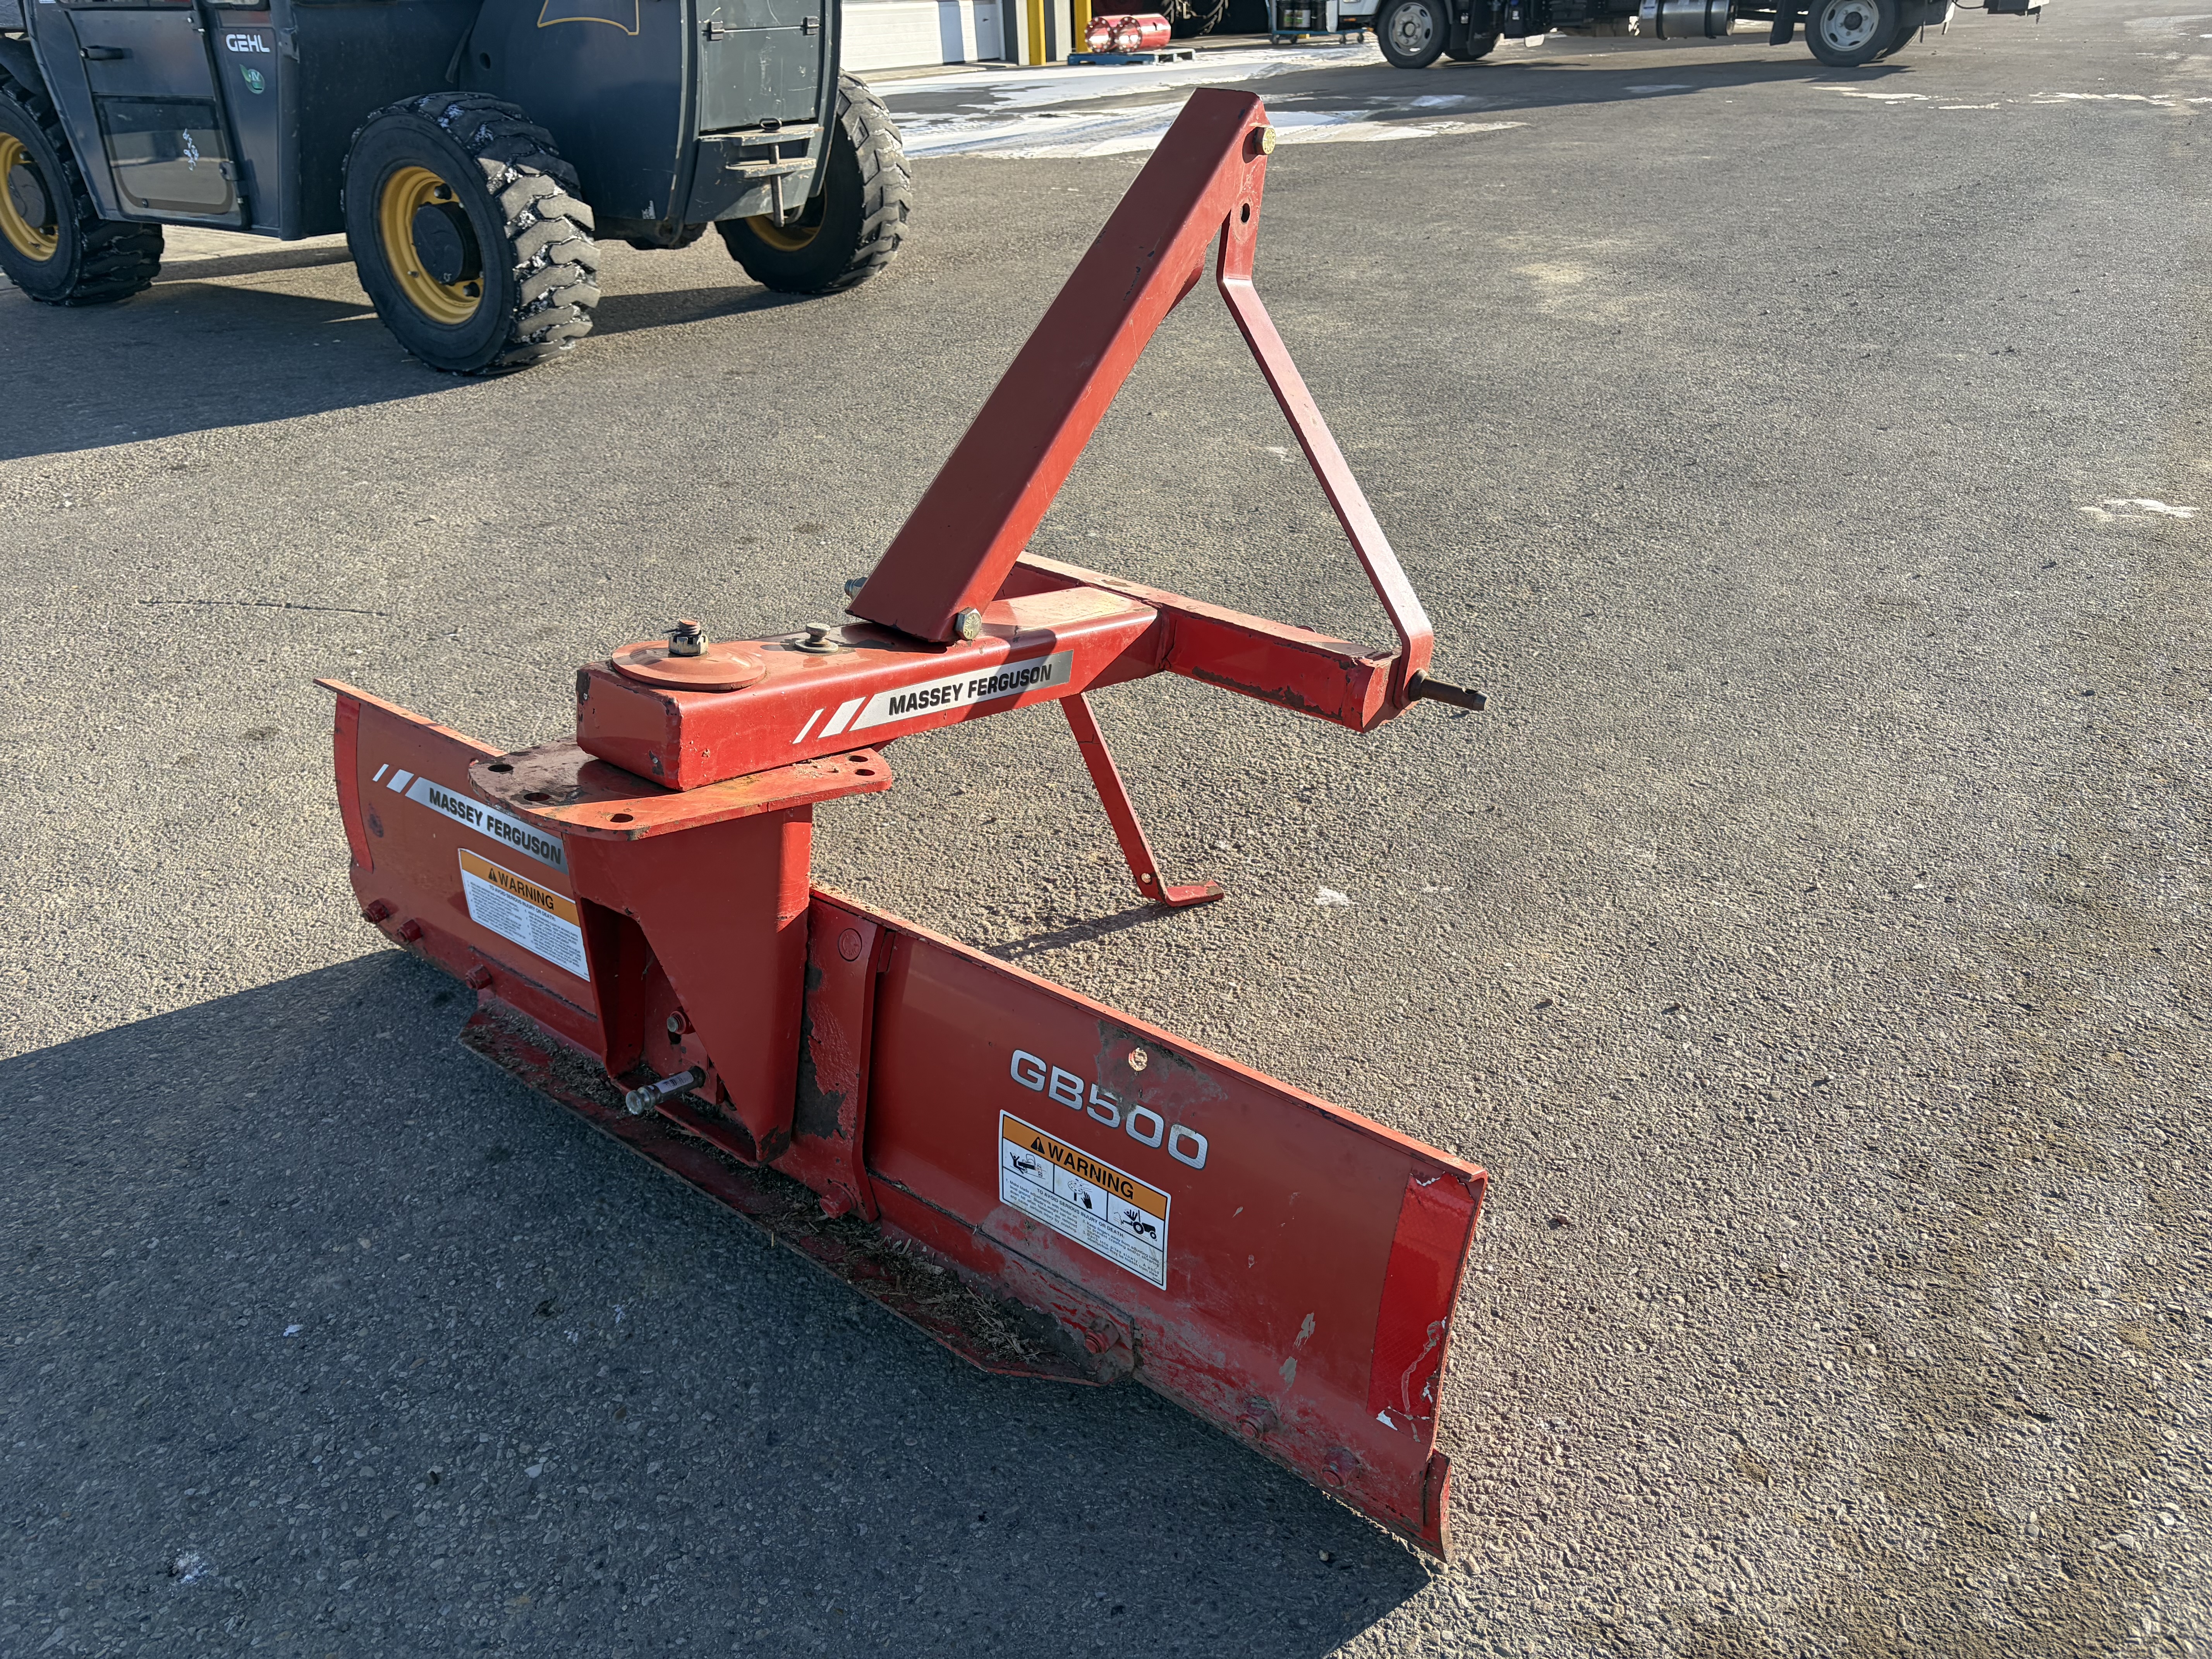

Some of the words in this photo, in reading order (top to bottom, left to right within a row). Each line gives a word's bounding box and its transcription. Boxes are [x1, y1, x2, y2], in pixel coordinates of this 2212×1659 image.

[226, 34, 270, 53] GEHL
[889, 683, 963, 716] MASSEY
[967, 664, 1052, 699] FERGUSON
[429, 788, 483, 826] MASSEY
[486, 815, 562, 866] FERGUSON
[498, 871, 555, 912] WARNING
[1010, 1049, 1208, 1170] GB500
[1048, 1141, 1134, 1200] WARNING
[1044, 1192, 1058, 1203] AVOID
[1059, 1200, 1080, 1214] SERIOUS
[1080, 1211, 1097, 1224] INJURY
[1099, 1221, 1106, 1229] OR
[1107, 1225, 1125, 1239] DEATH:
